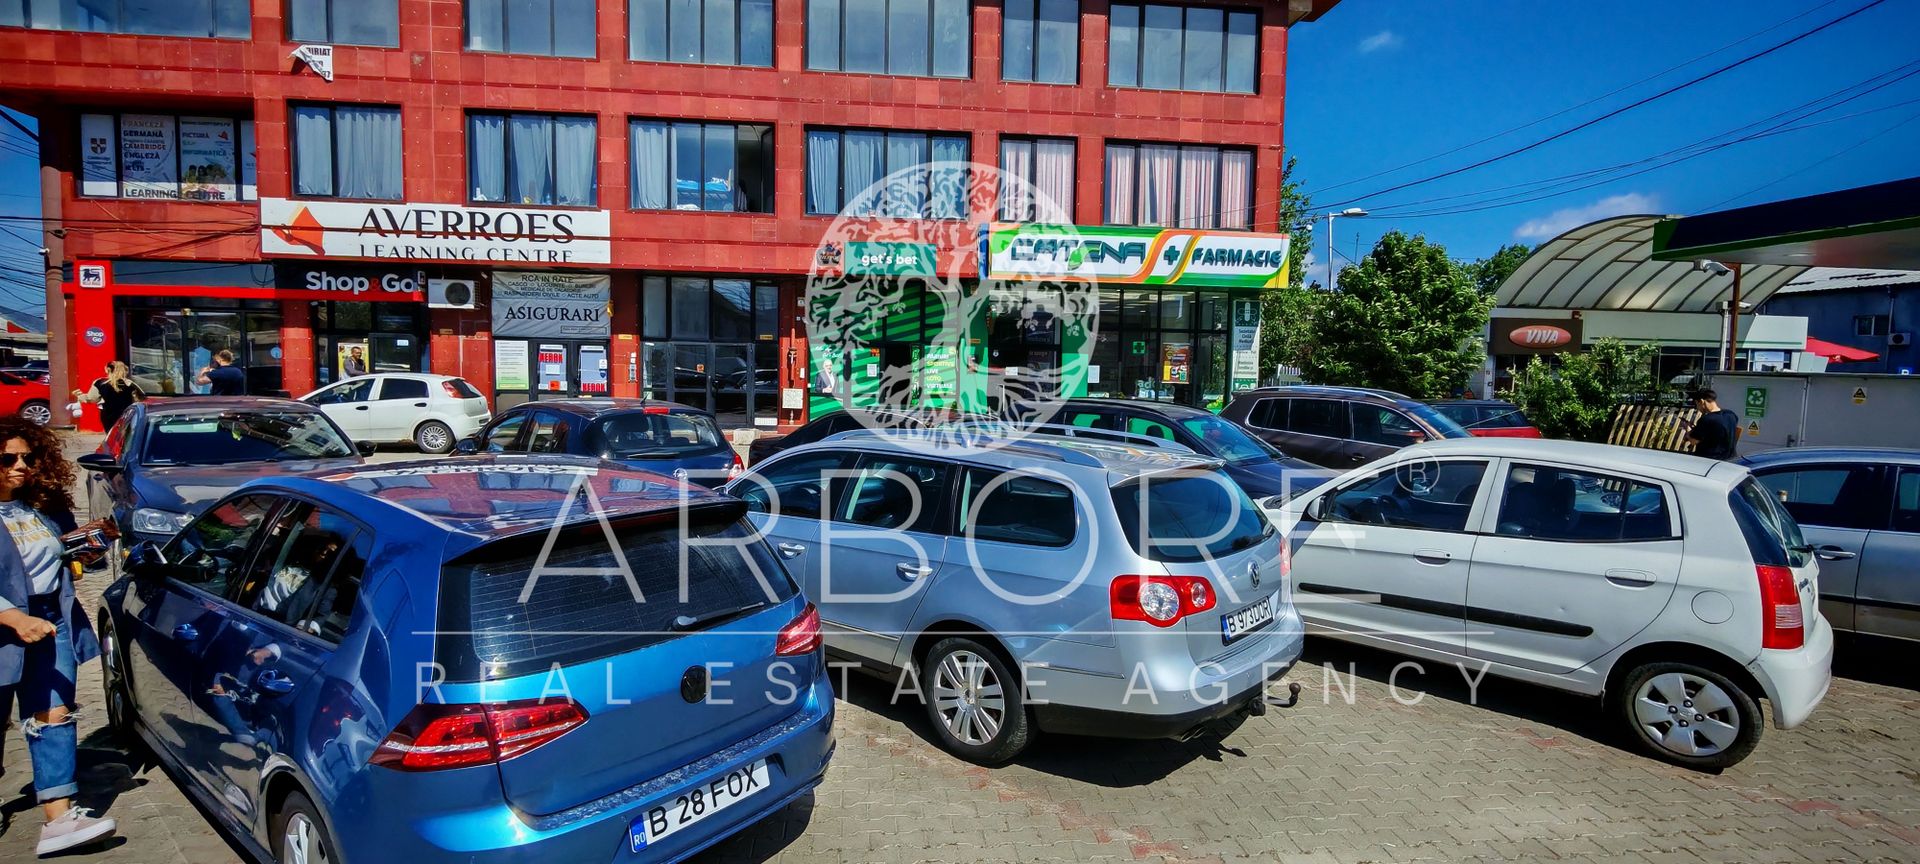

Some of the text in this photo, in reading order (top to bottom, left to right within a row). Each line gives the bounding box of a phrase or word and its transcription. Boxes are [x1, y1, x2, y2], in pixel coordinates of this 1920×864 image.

[125, 188, 225, 200] LEARNING CENTRE
[358, 207, 574, 244] AVERROES
[360, 244, 573, 263] LEARNING CENTRE
[861, 253, 917, 266] get's bet
[1191, 247, 1282, 269] FARMACIE
[505, 307, 600, 322] ASIGURARI
[1526, 329, 1559, 344] VIVA
[1228, 615, 1236, 632] B
[648, 763, 759, 838] B 28 FOX
[633, 831, 646, 847] RO
